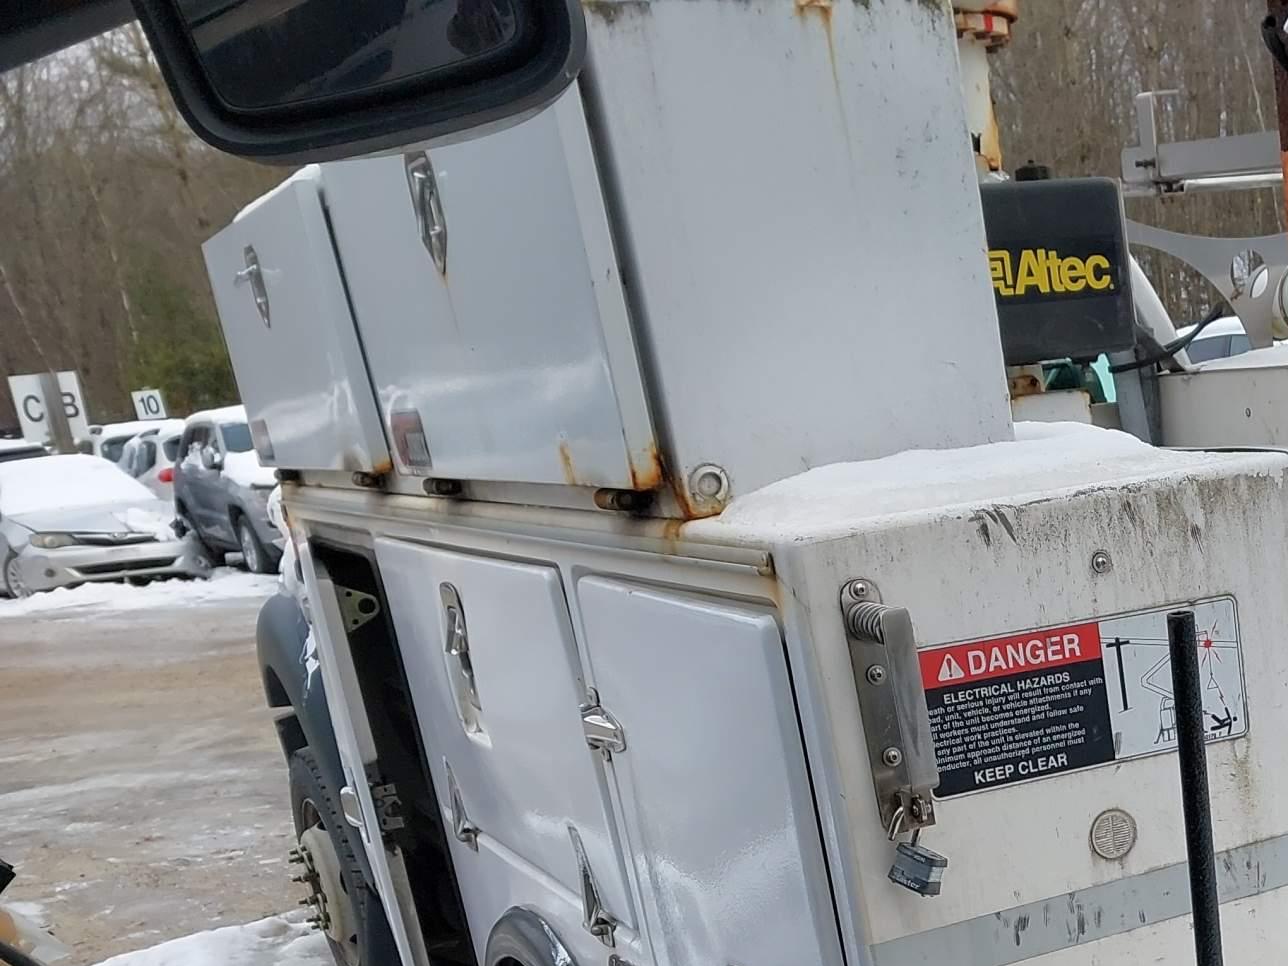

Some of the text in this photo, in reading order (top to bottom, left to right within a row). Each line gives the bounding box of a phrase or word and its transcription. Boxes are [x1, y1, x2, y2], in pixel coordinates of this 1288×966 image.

[1014, 248, 1112, 296] Altec
[23, 394, 44, 422] C
[138, 394, 161, 415] 10
[967, 633, 1081, 676] DANGER
[928, 706, 946, 717] eath
[946, 705, 955, 713] or
[956, 699, 984, 711] serious
[1007, 692, 1020, 702] will
[1021, 687, 1042, 699] result
[1043, 684, 1060, 695] from
[1061, 679, 1088, 691] contact
[1088, 676, 1104, 687] with
[943, 672, 1071, 705] ELECTRICAL HAZARDS
[927, 715, 944, 727] oad,
[992, 704, 1001, 713] or
[1002, 698, 1028, 711] vehicle
[1029, 692, 1072, 706] attachments
[1072, 688, 1079, 697] if
[1079, 687, 1092, 697] any
[930, 703, 1052, 733] art of the unit becomes energized.
[939, 727, 969, 739] workers
[970, 722, 989, 733] must
[989, 714, 1030, 729] understand
[1031, 712, 1045, 722] and
[1046, 707, 1068, 719] follow
[1068, 704, 1085, 715] safe
[935, 726, 1019, 748] ectrical work practices.
[936, 721, 1080, 758] any part of the unit is elevated within the
[966, 745, 1001, 760] approach
[1001, 740, 1032, 752] distance
[1033, 736, 1041, 745] of
[1041, 735, 1052, 744] an
[1052, 728, 1086, 742] energized
[936, 760, 973, 774] onductor,
[983, 748, 1030, 764] unauthorized
[1031, 740, 1066, 755] personnel
[1067, 736, 1085, 747] must
[974, 752, 1069, 785] KEEP CLEAR
